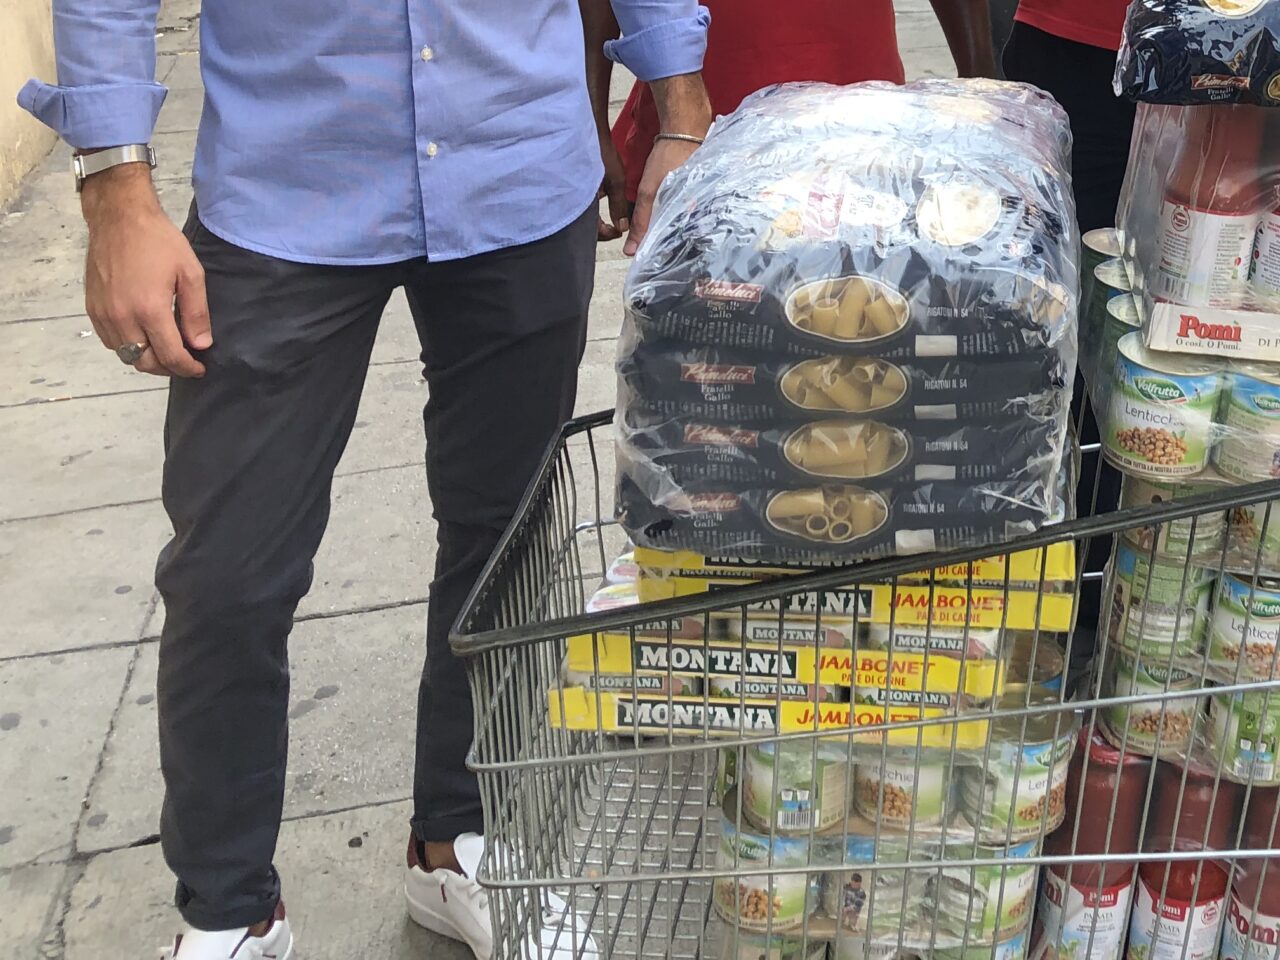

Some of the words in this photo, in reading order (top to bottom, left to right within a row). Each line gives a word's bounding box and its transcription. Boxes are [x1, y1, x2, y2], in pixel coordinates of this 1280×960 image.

[1177, 314, 1241, 342] Pomì
[1258, 338, 1270, 347] DI
[701, 384, 734, 393] Fratelli
[924, 379, 951, 390] RIGATONI
[1137, 379, 1180, 397] Valfrutta
[704, 393, 731, 401] Gallo
[704, 445, 738, 455] Fratelli
[939, 566, 952, 575] DI
[939, 612, 952, 622] DI
[640, 645, 792, 675] MONTANA
[813, 655, 936, 676] JAMBONET
[592, 677, 662, 689] MONTANA
[865, 674, 875, 684] DI
[737, 682, 807, 697] MONTANA
[880, 691, 949, 705] MONTANA
[623, 703, 774, 729] MONTANA
